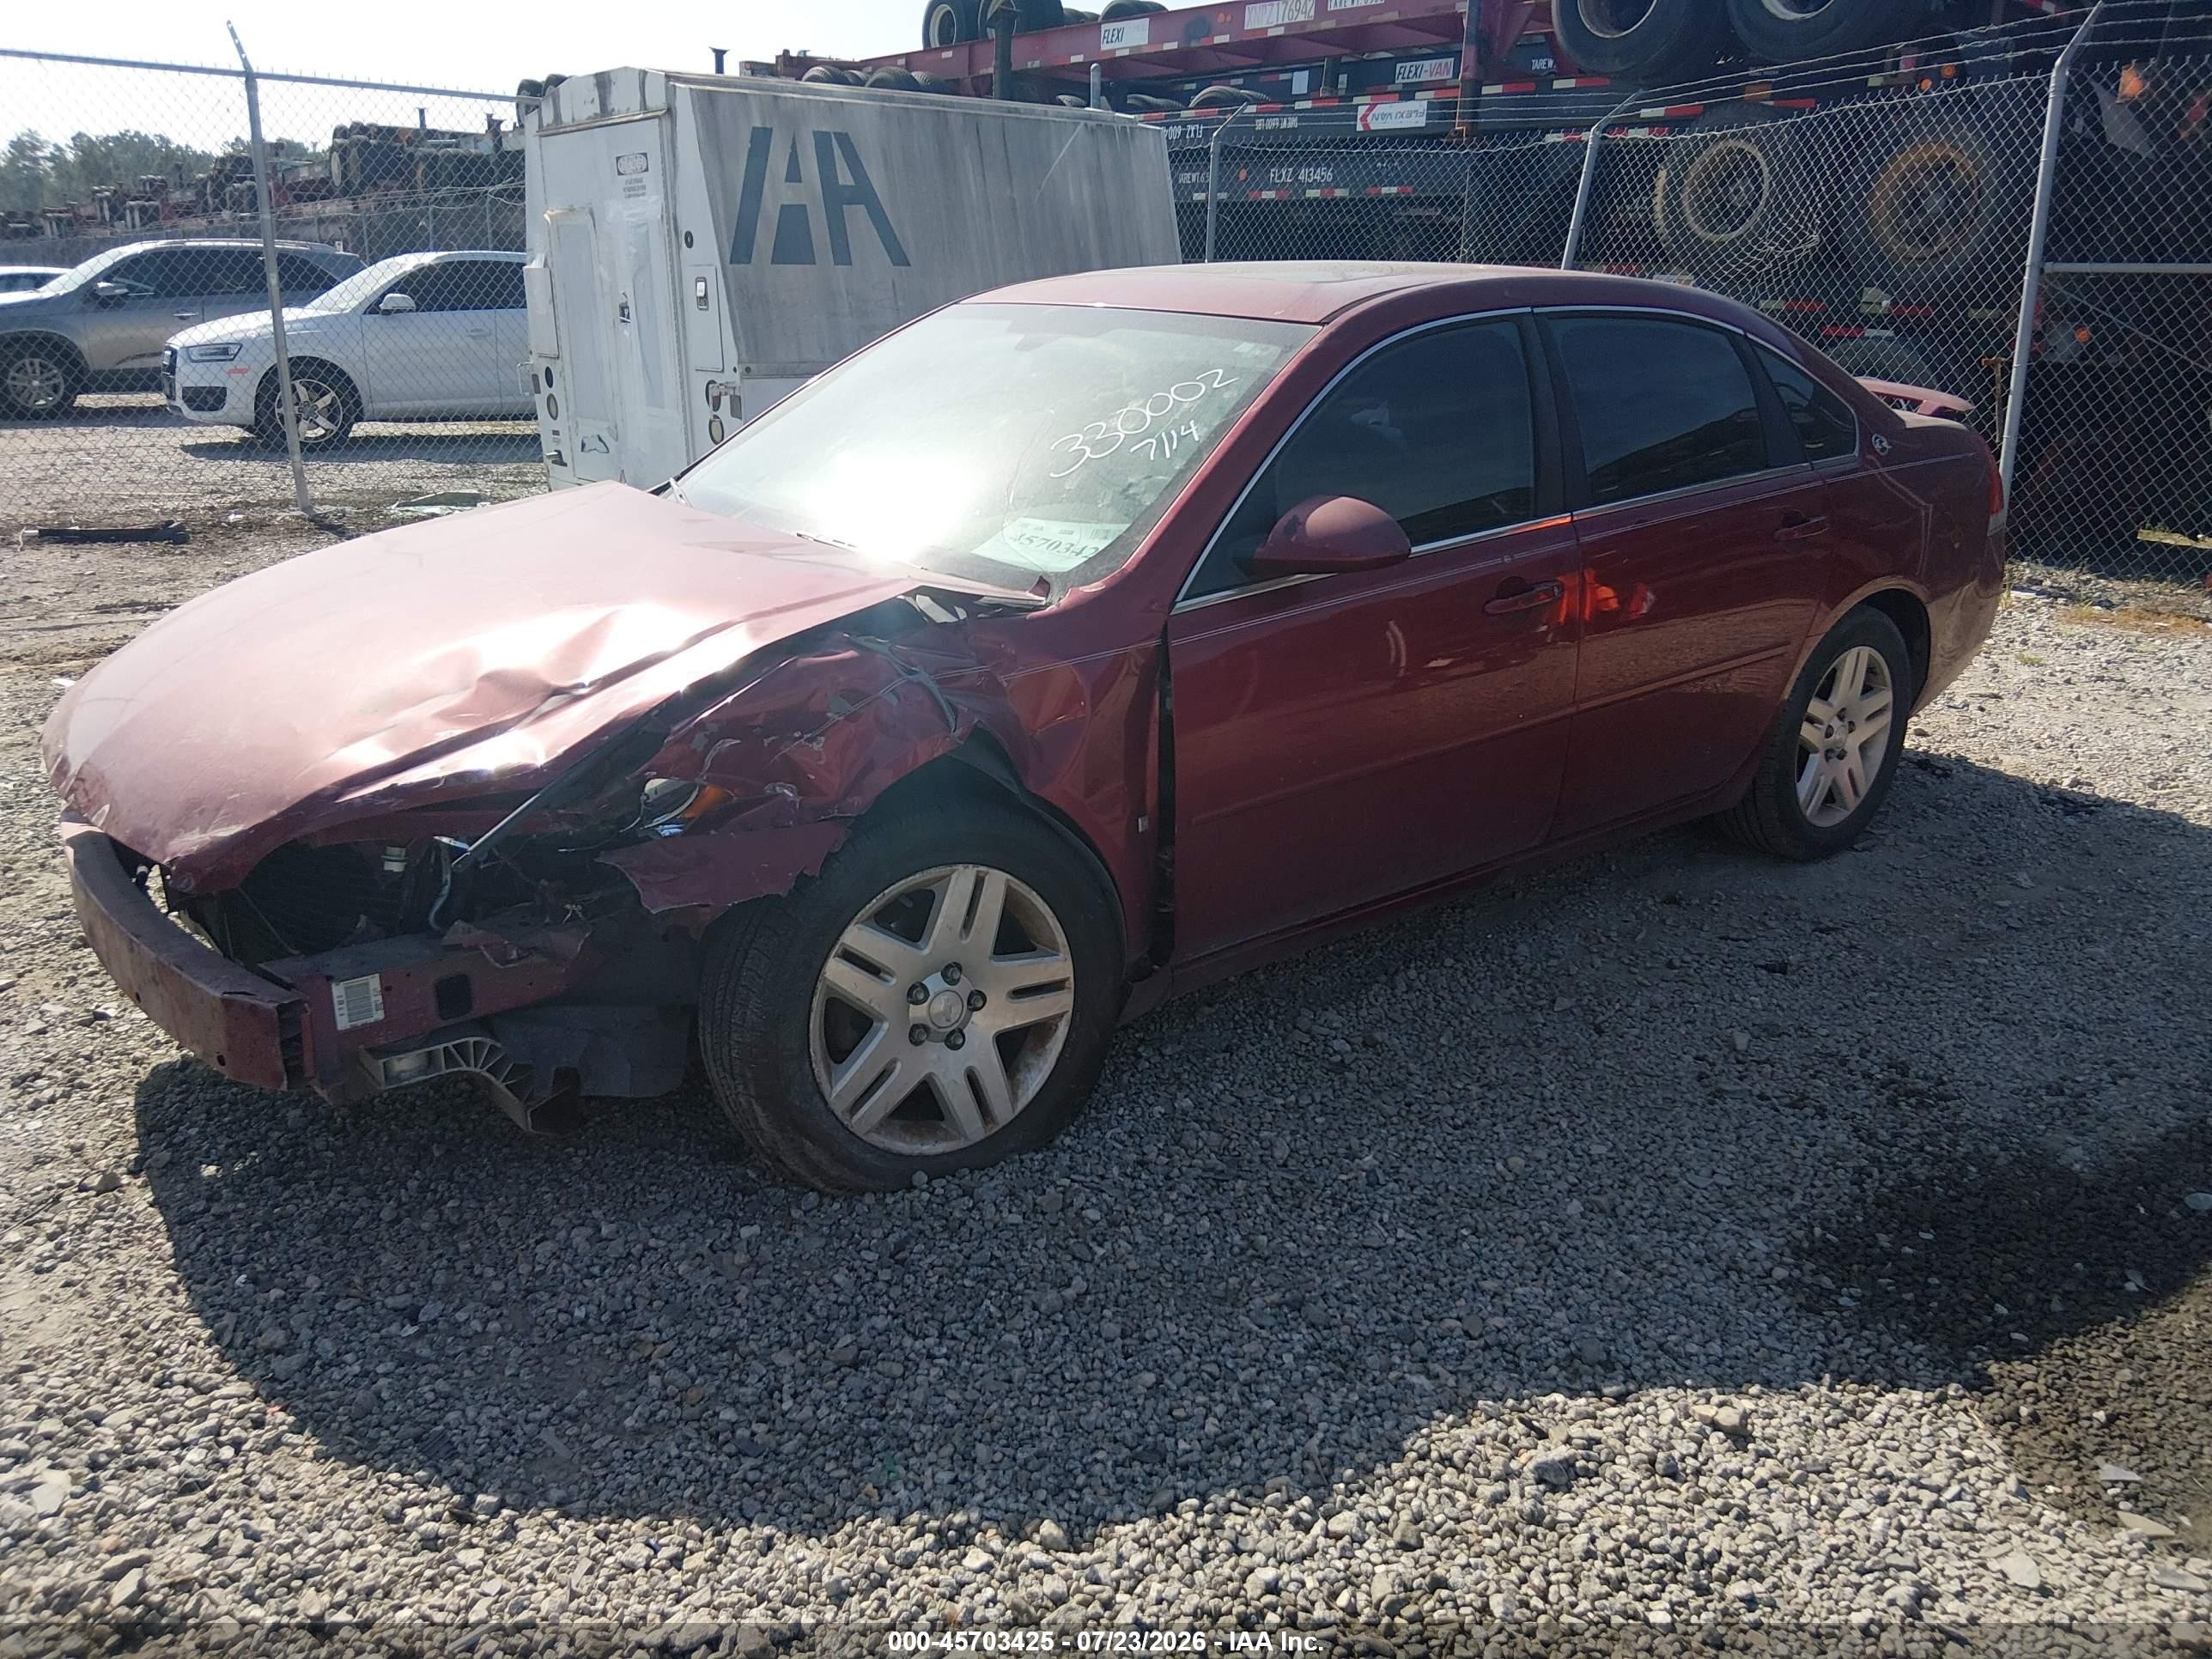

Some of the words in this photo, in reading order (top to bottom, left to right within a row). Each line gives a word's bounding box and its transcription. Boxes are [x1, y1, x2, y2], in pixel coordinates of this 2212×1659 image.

[1102, 27, 1125, 45] FLEXI
[1397, 60, 1452, 80] FLEXI-VAN
[1531, 58, 1547, 70] TARE
[1186, 124, 1203, 139] FLXZ
[1270, 167, 1293, 184] FLXZ
[1297, 167, 1333, 183] 413456
[1049, 368, 1239, 477] 330002
